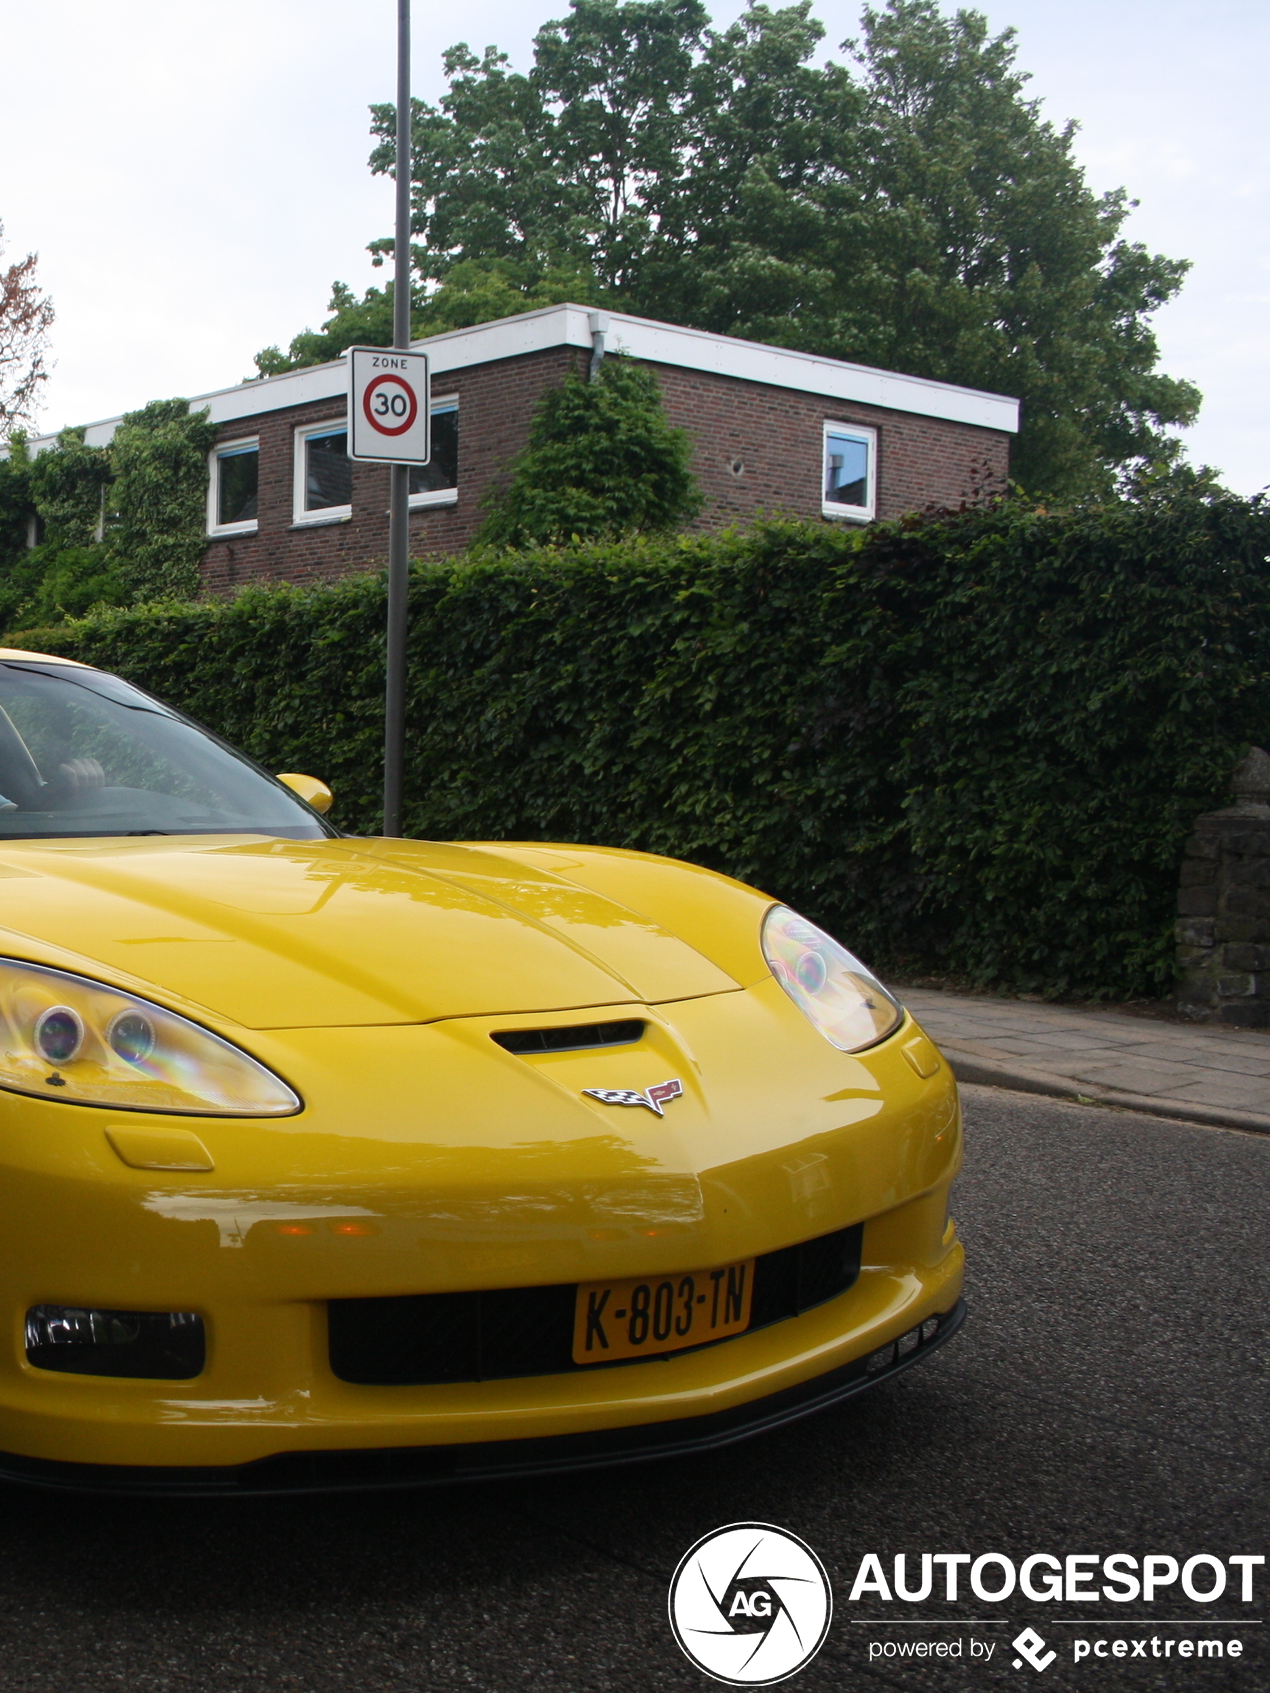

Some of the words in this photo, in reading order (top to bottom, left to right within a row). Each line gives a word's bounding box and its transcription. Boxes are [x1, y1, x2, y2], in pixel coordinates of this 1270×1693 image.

[372, 357, 408, 369] ZONE
[374, 393, 407, 417] 30
[585, 1264, 746, 1351] K-803-TN
